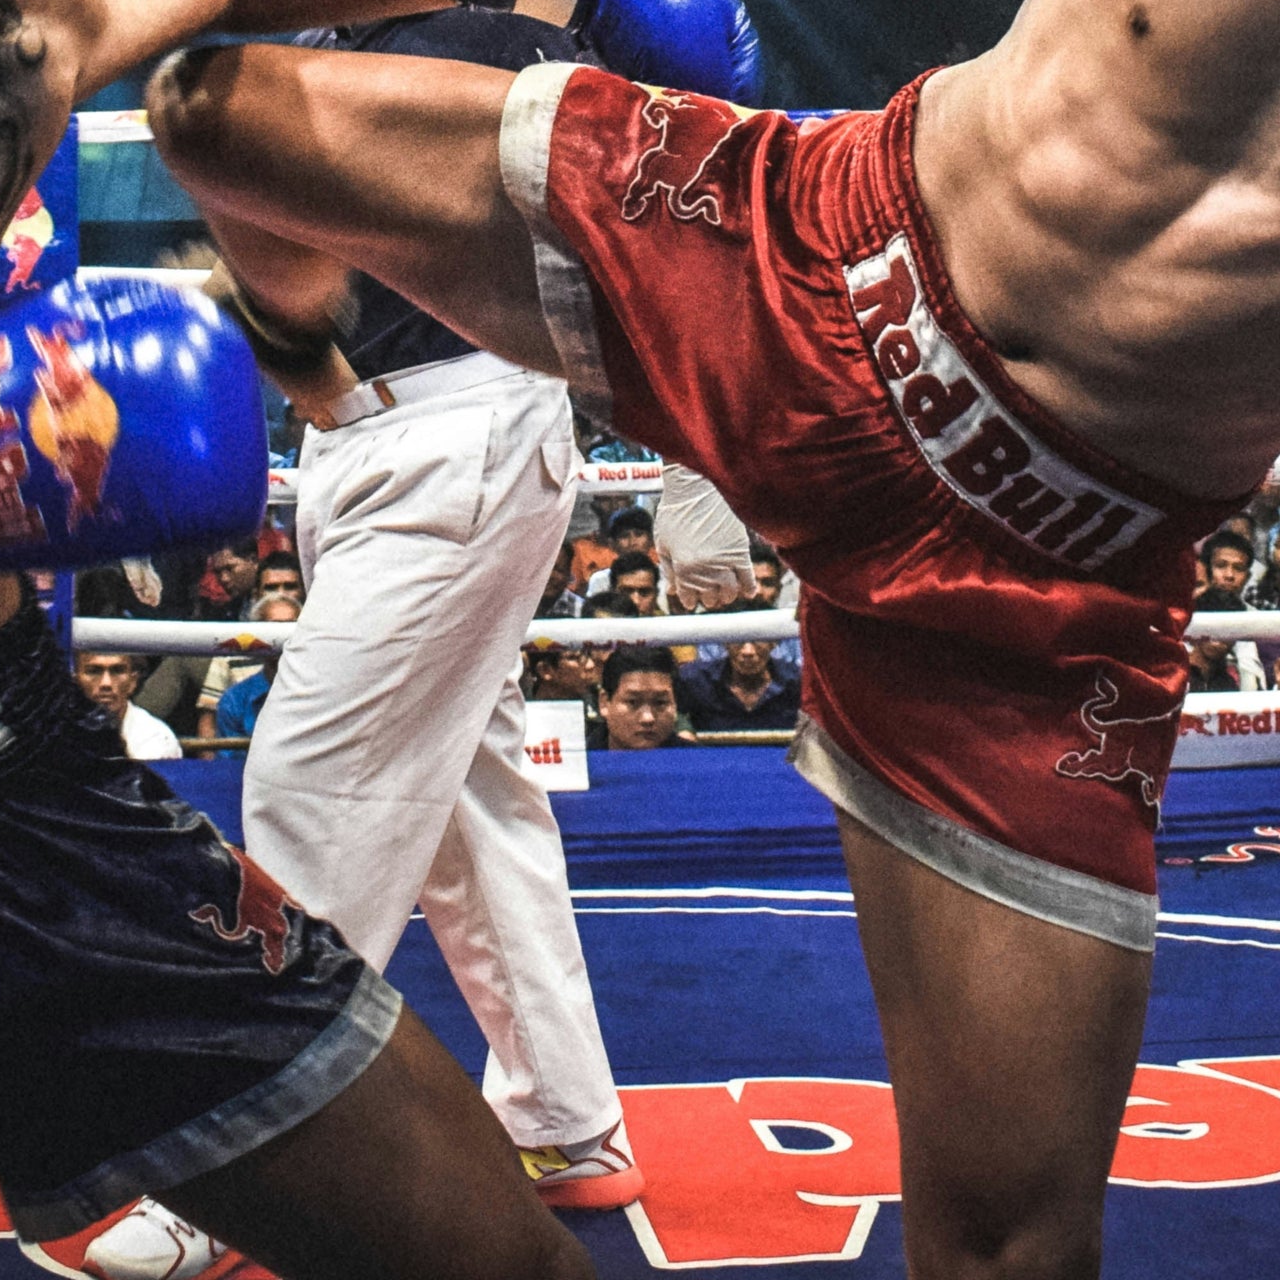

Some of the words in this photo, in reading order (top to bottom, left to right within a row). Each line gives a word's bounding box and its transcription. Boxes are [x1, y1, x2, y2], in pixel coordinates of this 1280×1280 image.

[851, 255, 980, 439] Red
[940, 414, 1140, 569] Bull
[598, 467, 628, 481] Red
[1217, 707, 1273, 736] Red
